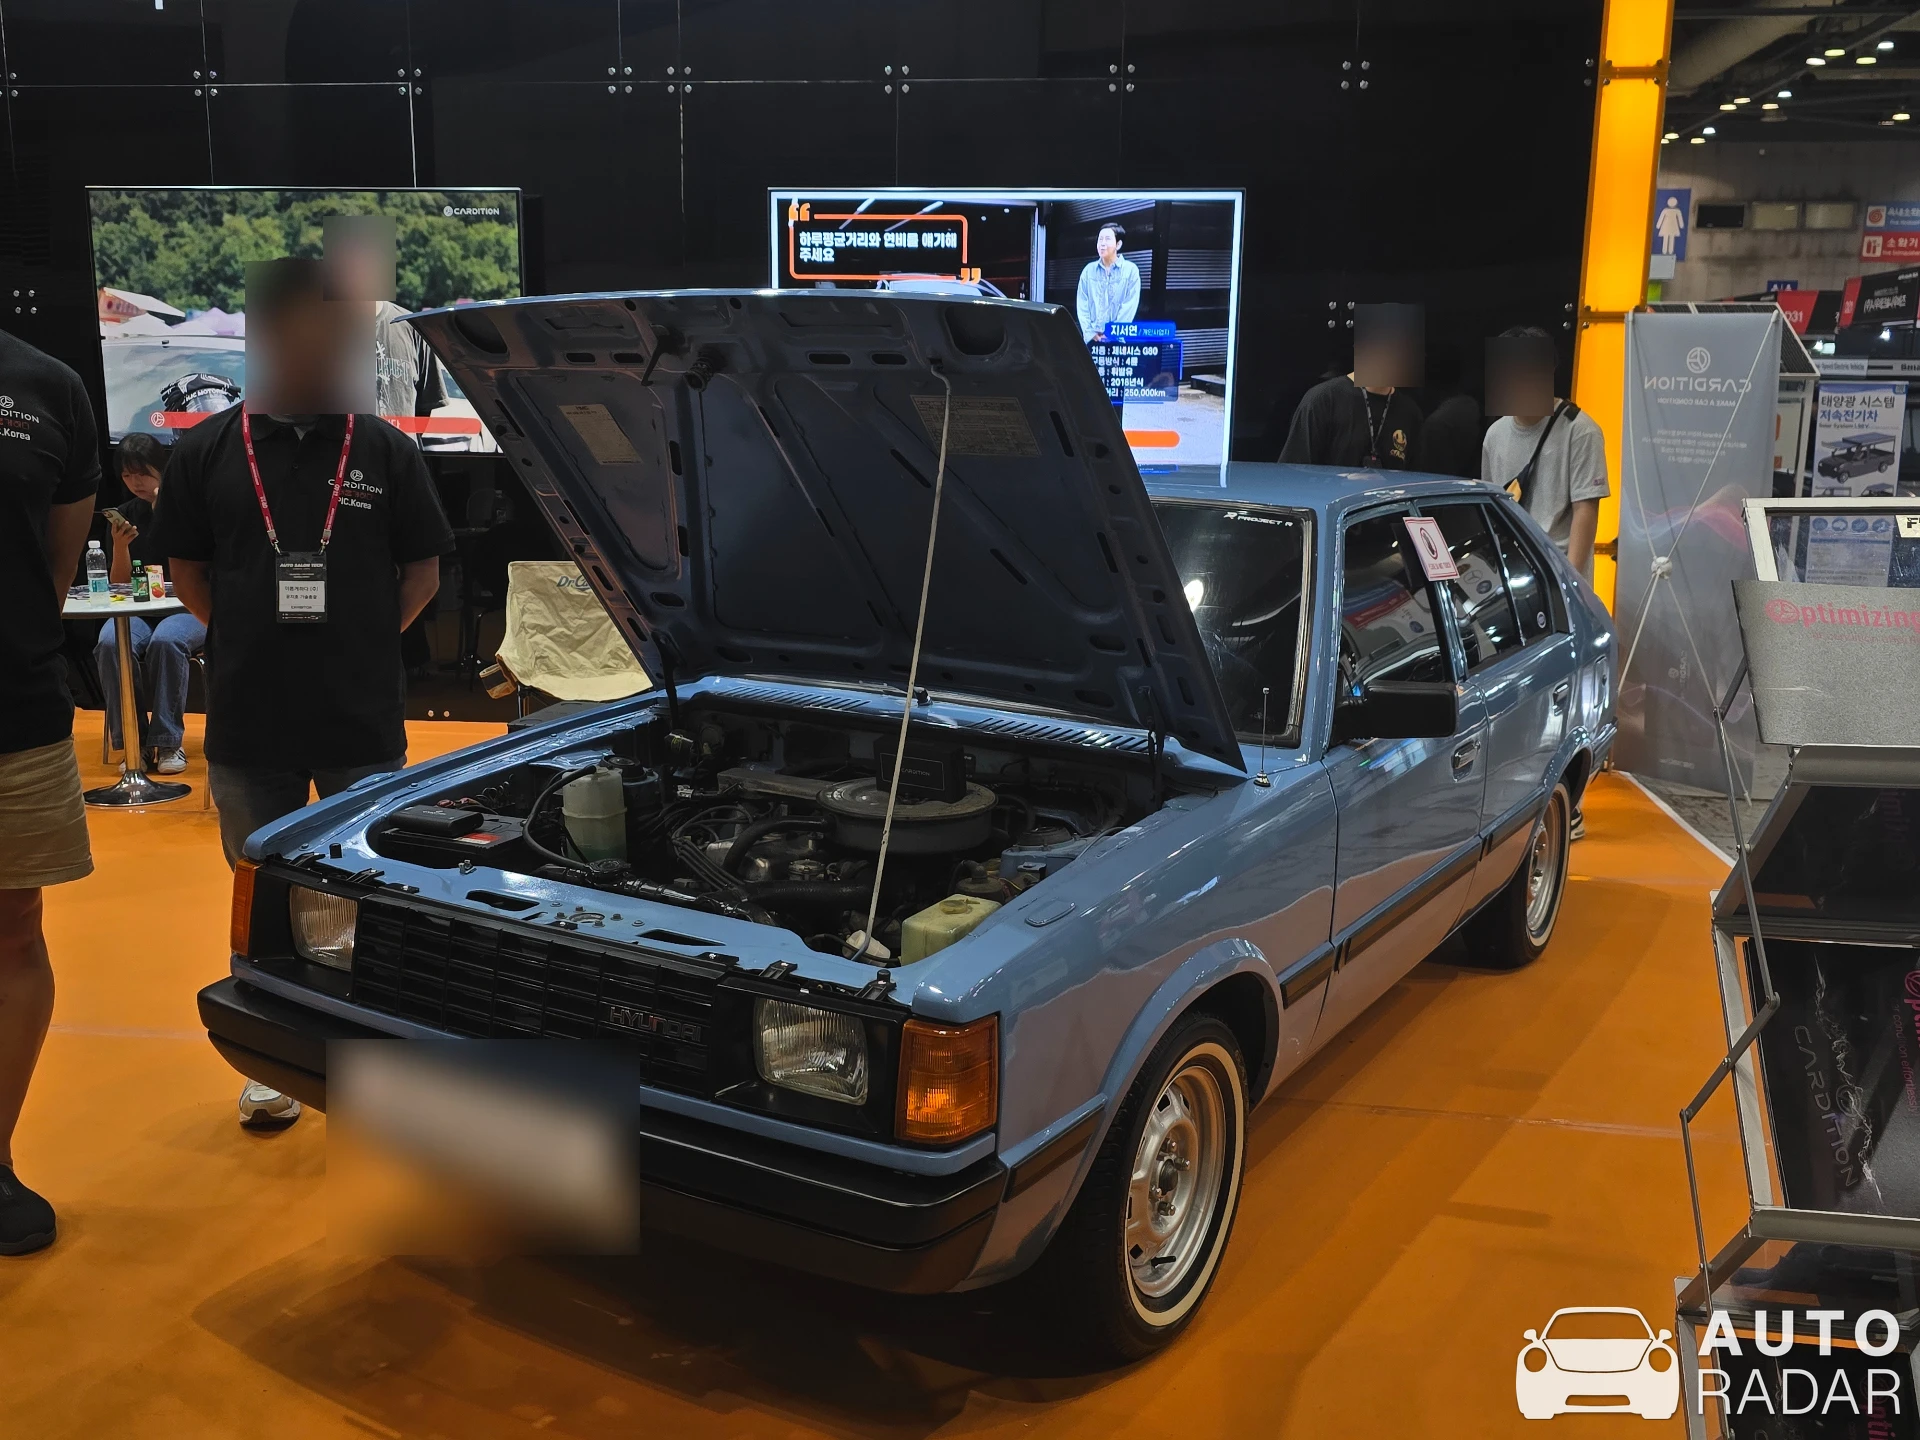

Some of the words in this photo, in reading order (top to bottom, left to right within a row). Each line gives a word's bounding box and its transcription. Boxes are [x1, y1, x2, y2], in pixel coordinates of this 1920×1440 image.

[454, 207, 500, 215] CARDITION
[799, 231, 881, 248] 하루평균거리와
[883, 232, 919, 248] 연비를
[921, 232, 957, 248] 얘기해
[799, 248, 835, 262] 주세요
[1110, 324, 1138, 337] 지서연
[1112, 346, 1141, 355] 제네시스
[1142, 346, 1159, 356] G80
[1821, 395, 1856, 408] 태양광
[1859, 395, 1896, 409] 시스템
[1819, 409, 1879, 423] 저속전기차
[327, 478, 383, 495] CRDITION
[1237, 515, 1283, 526] PROJECT
[901, 767, 930, 776] CARDITION
[609, 1006, 702, 1042] HYUNDAI
[1794, 1025, 1859, 1188] CARDITION
